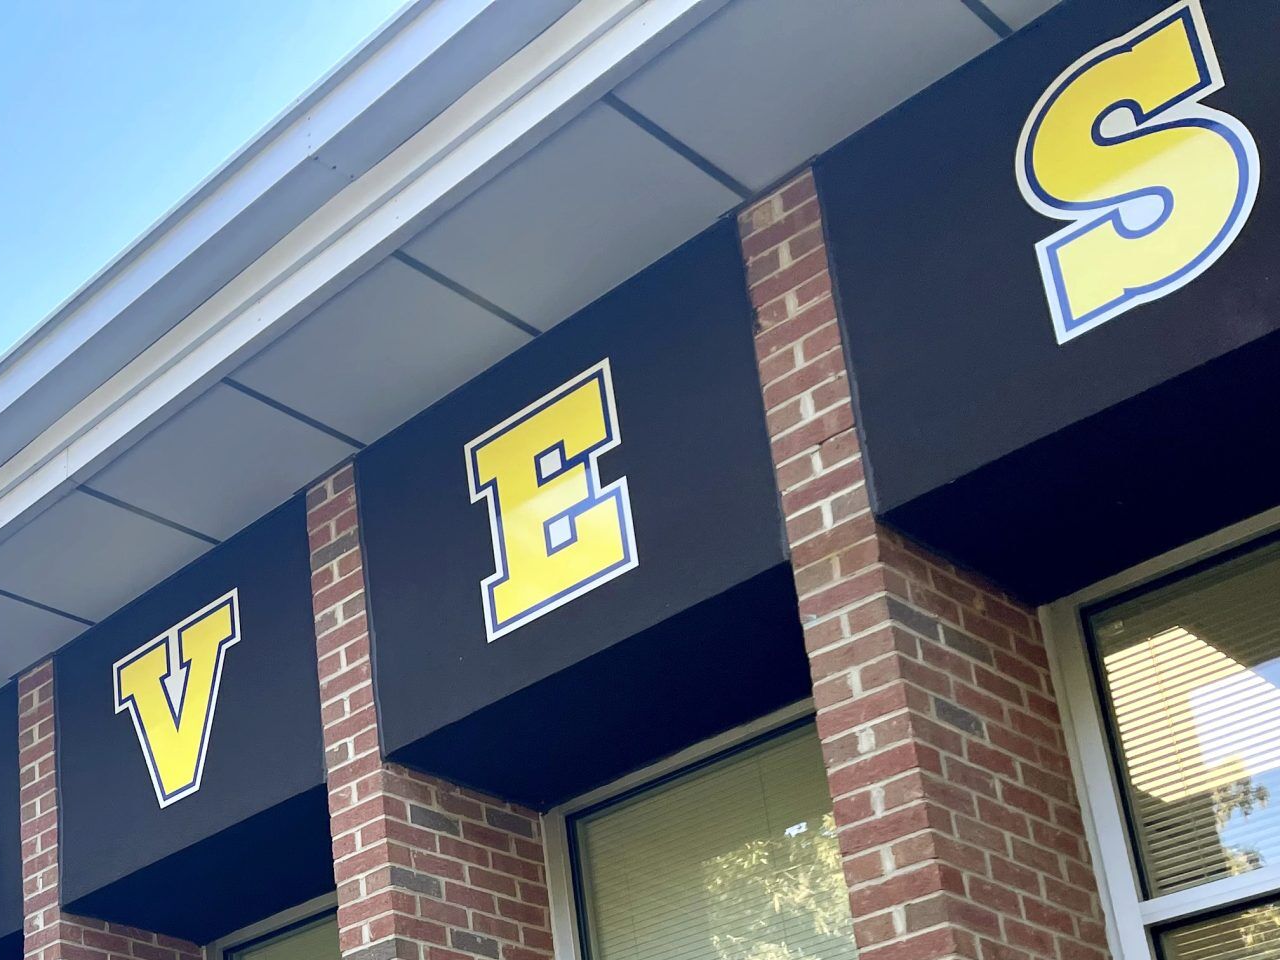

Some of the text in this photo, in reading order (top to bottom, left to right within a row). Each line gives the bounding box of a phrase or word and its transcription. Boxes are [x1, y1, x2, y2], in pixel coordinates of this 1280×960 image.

[113, 587, 241, 809] V
[464, 357, 639, 643] E
[1015, 0, 1260, 345] S
